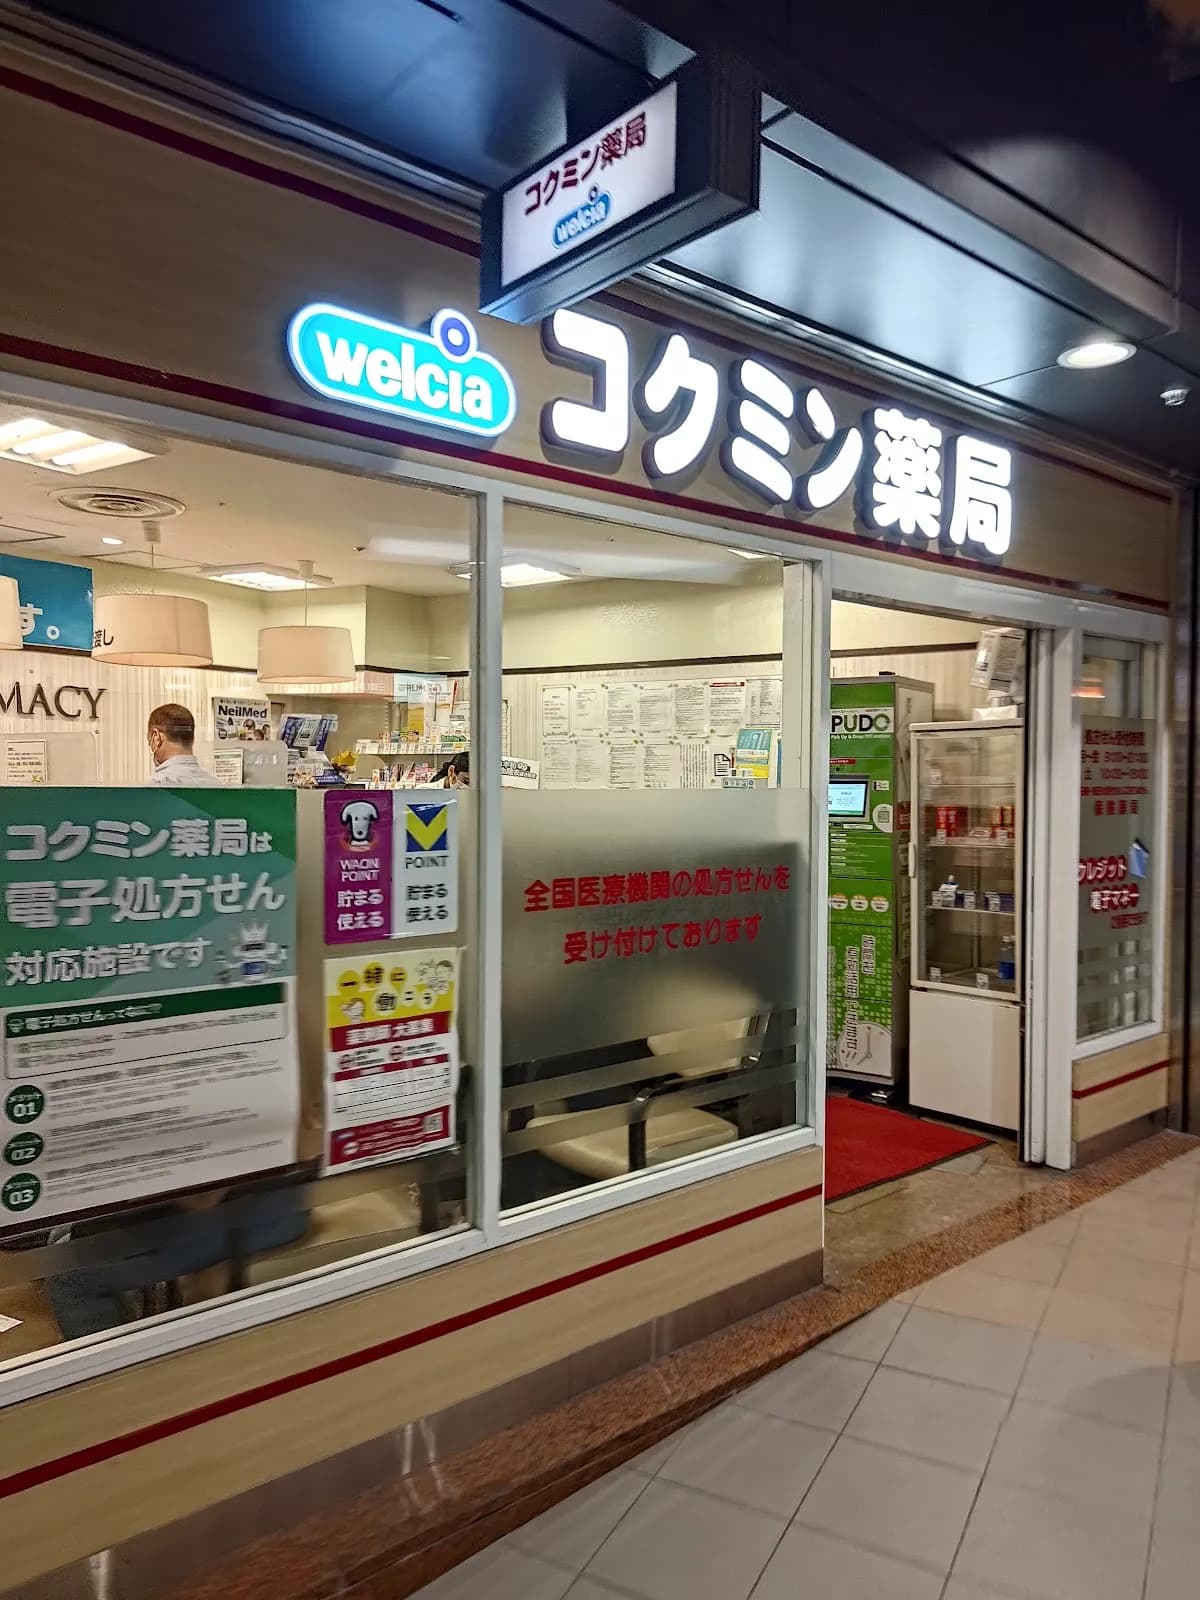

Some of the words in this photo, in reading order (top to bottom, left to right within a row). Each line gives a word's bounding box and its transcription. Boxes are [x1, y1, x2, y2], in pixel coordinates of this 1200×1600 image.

[524, 112, 647, 216] コクミン薬局
[555, 190, 608, 243] welcia
[314, 313, 495, 421] welcia
[549, 308, 1013, 556] コクミン薬局
[218, 705, 268, 719] NeilMed
[831, 713, 890, 732] PUDO
[6, 818, 272, 862] コクミン薬局は
[340, 858, 380, 870] WAON
[405, 856, 448, 869] POINT
[341, 870, 380, 882] POINT
[406, 884, 448, 901] 貯まる
[524, 864, 791, 912] 全国医療機関の処方せんを
[7, 873, 286, 928] 電子処方せん
[337, 889, 384, 908] 貯まる
[337, 911, 384, 931] 使える
[406, 905, 448, 923] 使える
[563, 915, 762, 965] 受け付けております
[6, 937, 211, 986] 対応施設です
[13, 1102, 38, 1118] 01
[11, 1147, 36, 1161] 02
[9, 1189, 34, 1205] 03
